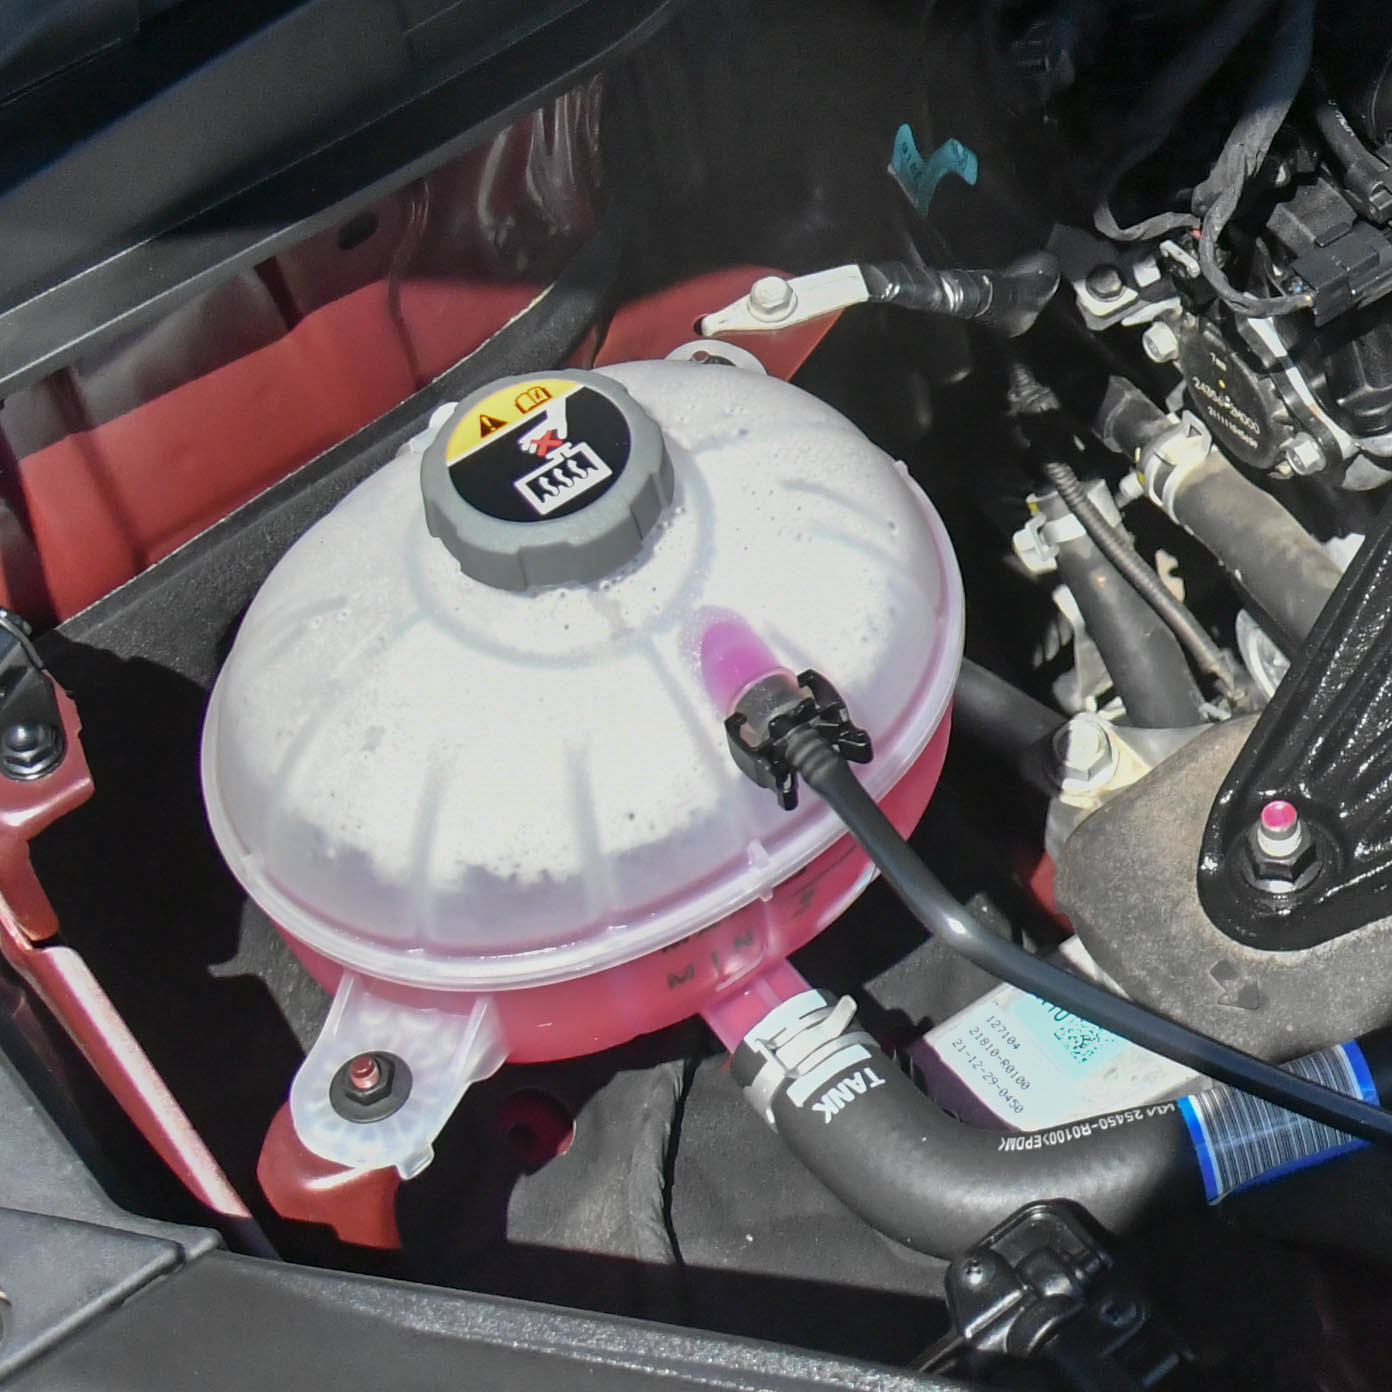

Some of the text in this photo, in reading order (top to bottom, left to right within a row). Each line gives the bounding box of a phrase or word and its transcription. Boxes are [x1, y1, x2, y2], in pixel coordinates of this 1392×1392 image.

[969, 1026, 1031, 1091] 21810-R0100
[986, 1013, 1022, 1051] 127104
[811, 1067, 887, 1125] TANK
[951, 1038, 1025, 1115] 21-12-29-0450
